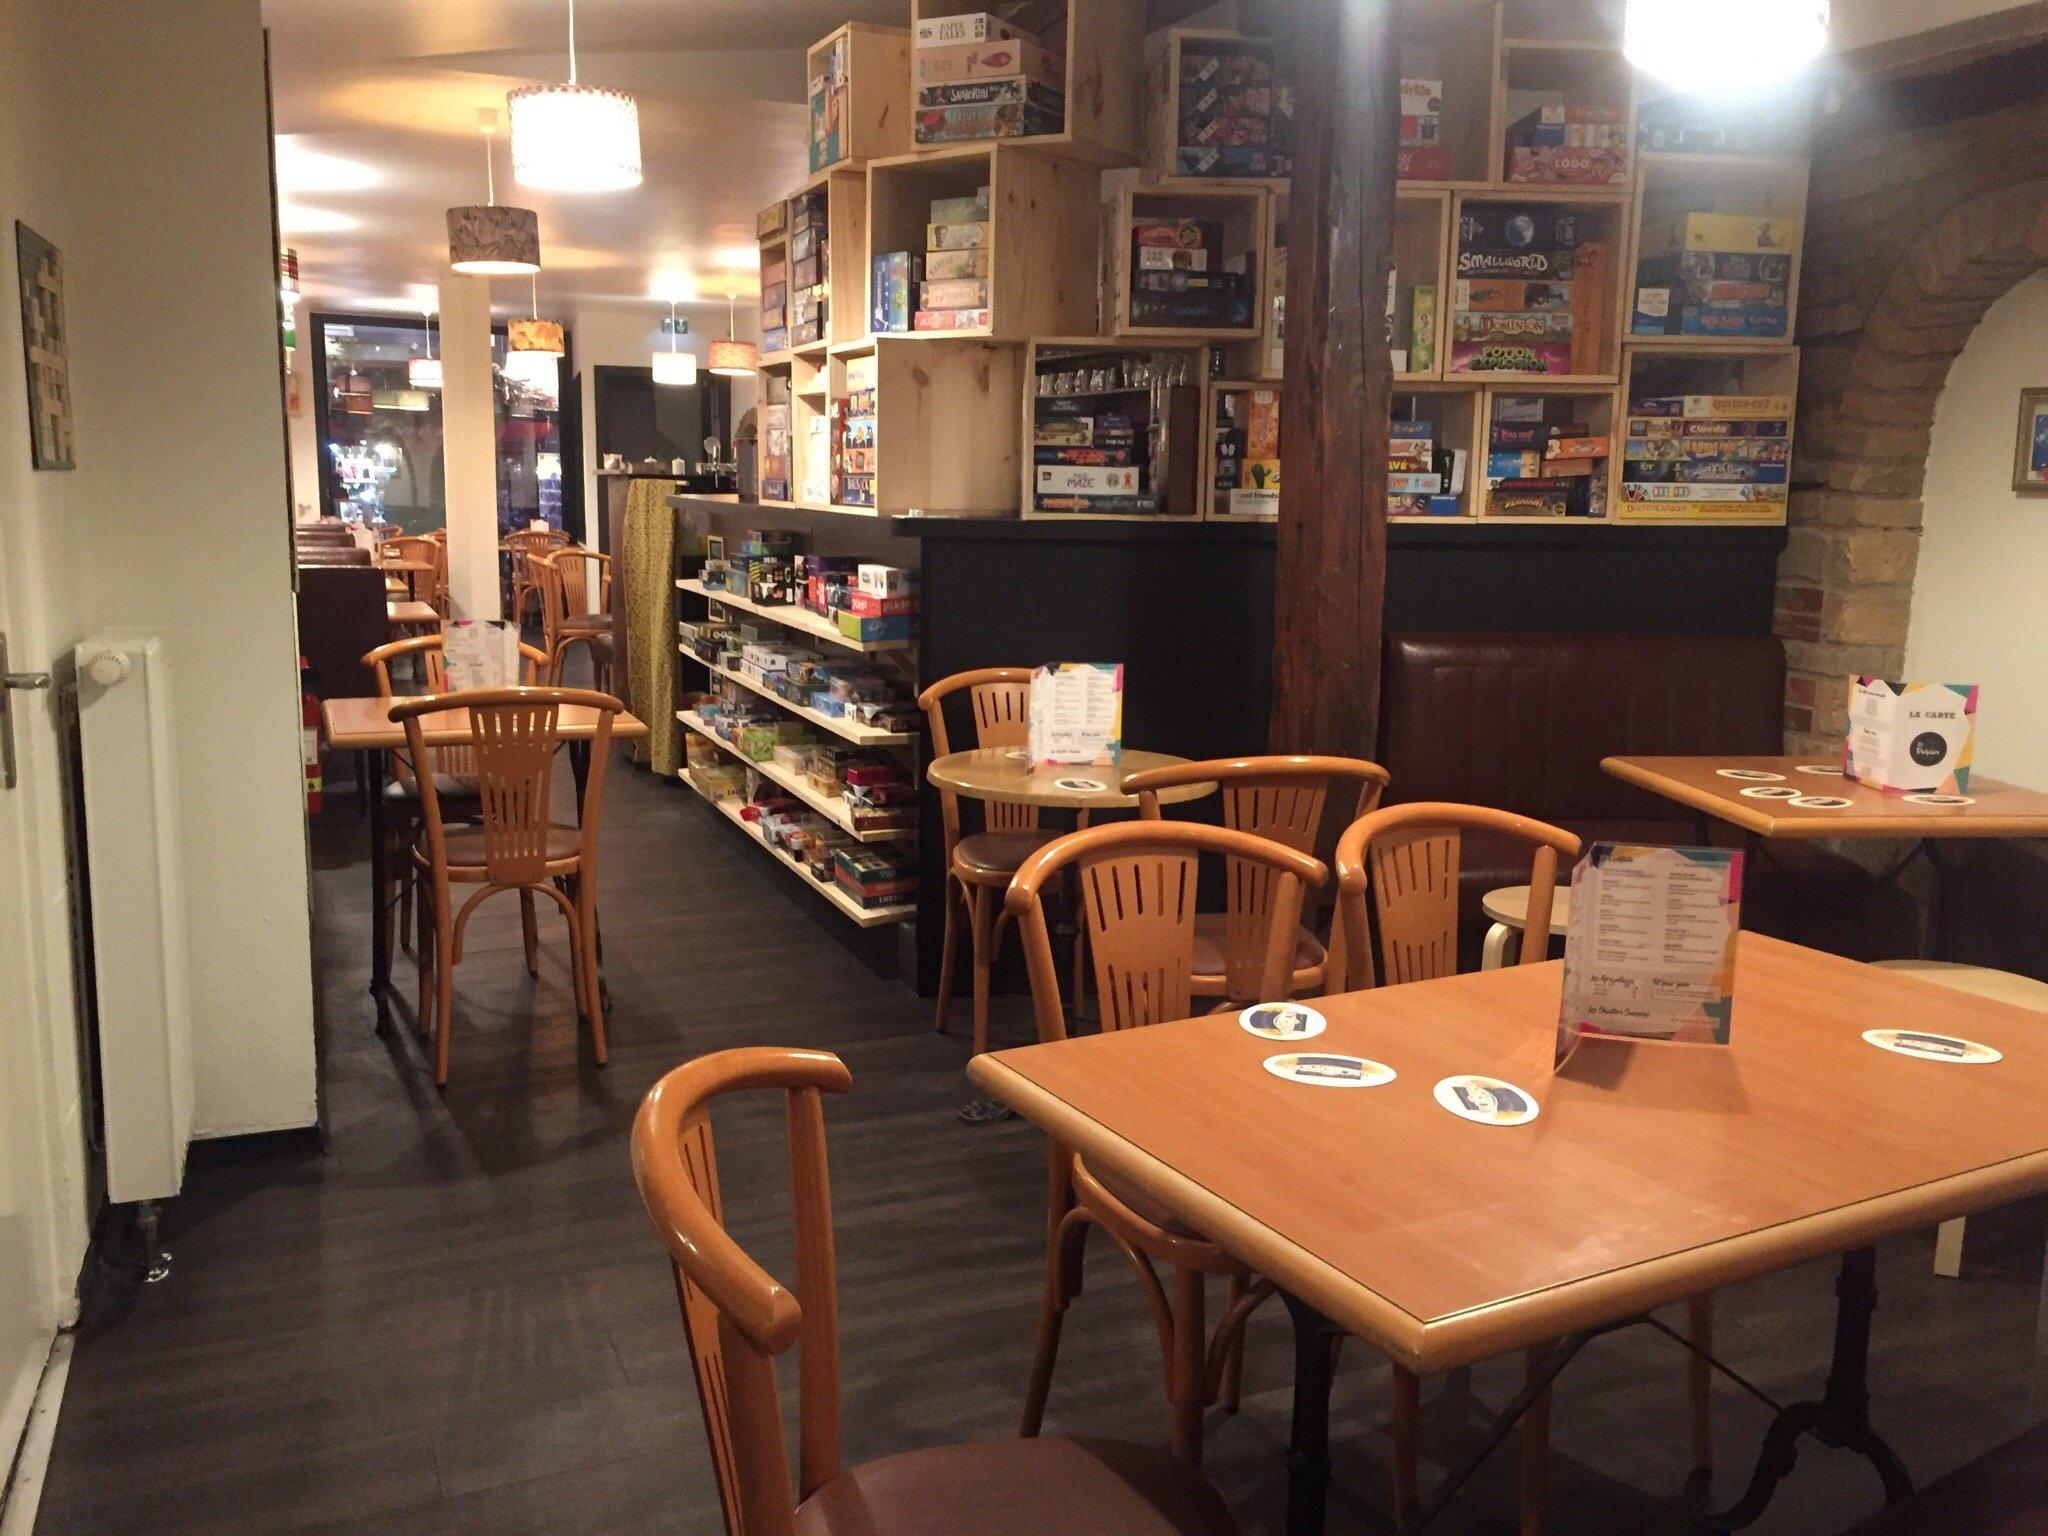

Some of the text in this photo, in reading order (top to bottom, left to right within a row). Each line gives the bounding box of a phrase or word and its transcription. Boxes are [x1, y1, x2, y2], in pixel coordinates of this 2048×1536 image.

[1554, 157, 1590, 169] LOGO
[1481, 316, 1544, 333] DOMINION
[1483, 346, 1536, 359] POTION
[1469, 357, 1548, 372] EXPLOSION
[1689, 424, 1727, 434] Cluedo
[1067, 478, 1095, 489] MAZE
[1925, 711, 1956, 719] CARTE
